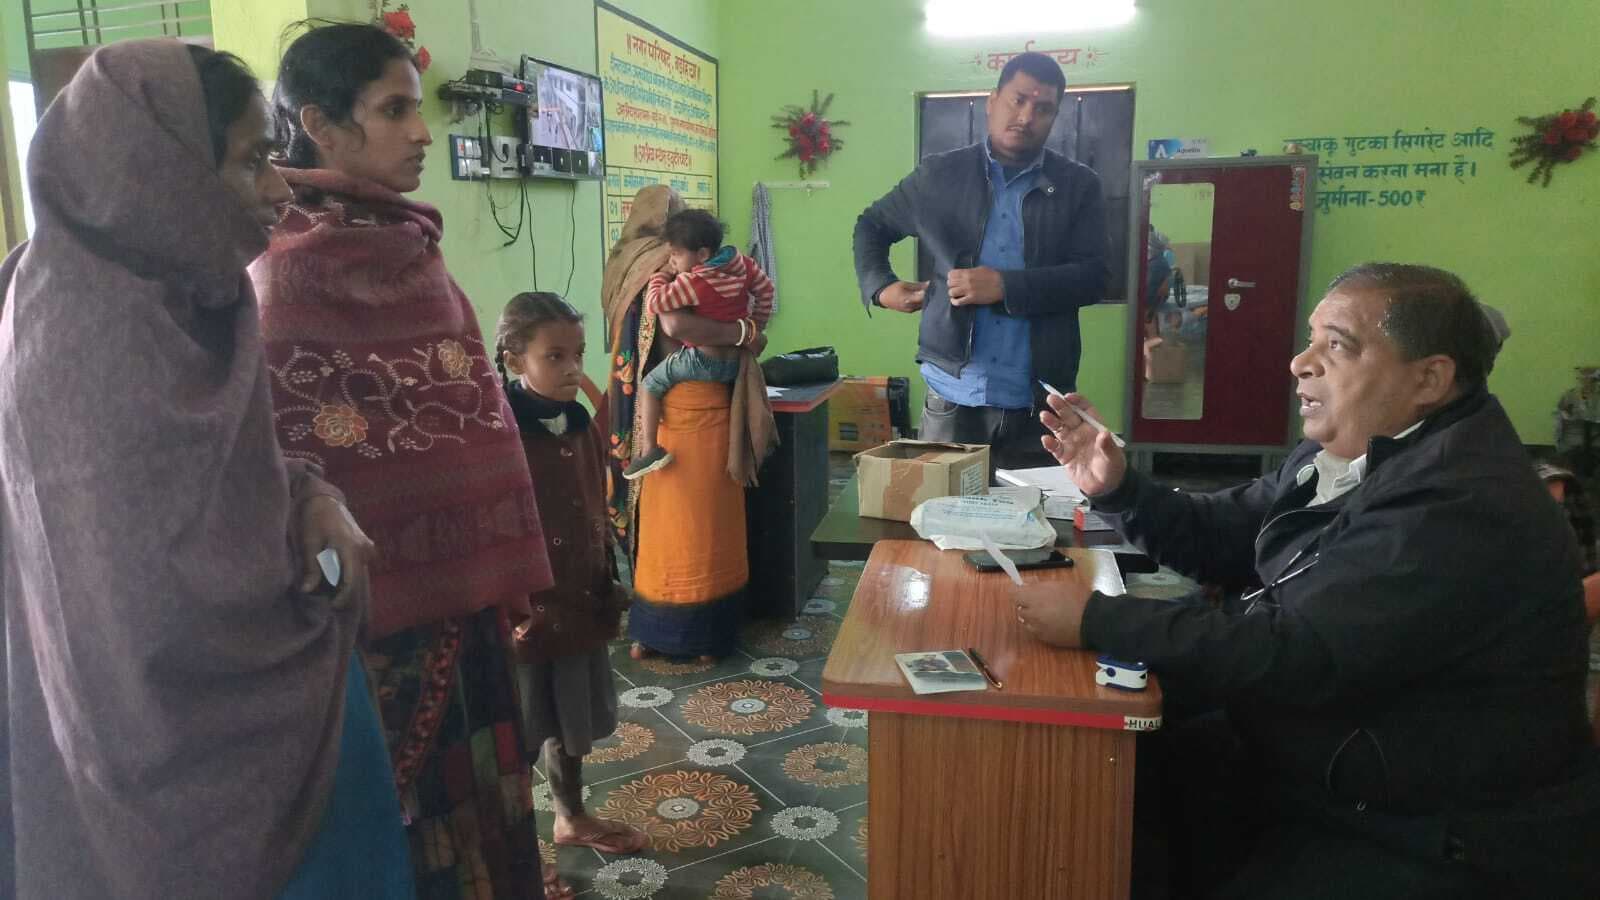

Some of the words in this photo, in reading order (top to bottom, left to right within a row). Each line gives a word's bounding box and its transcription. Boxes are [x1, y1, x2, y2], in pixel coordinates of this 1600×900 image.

[1343, 136, 1389, 156] गुटका
[1391, 127, 1447, 154] सिगरेट
[1452, 126, 1495, 149] आदि
[1362, 164, 1410, 183] करना
[1413, 162, 1449, 178] मना
